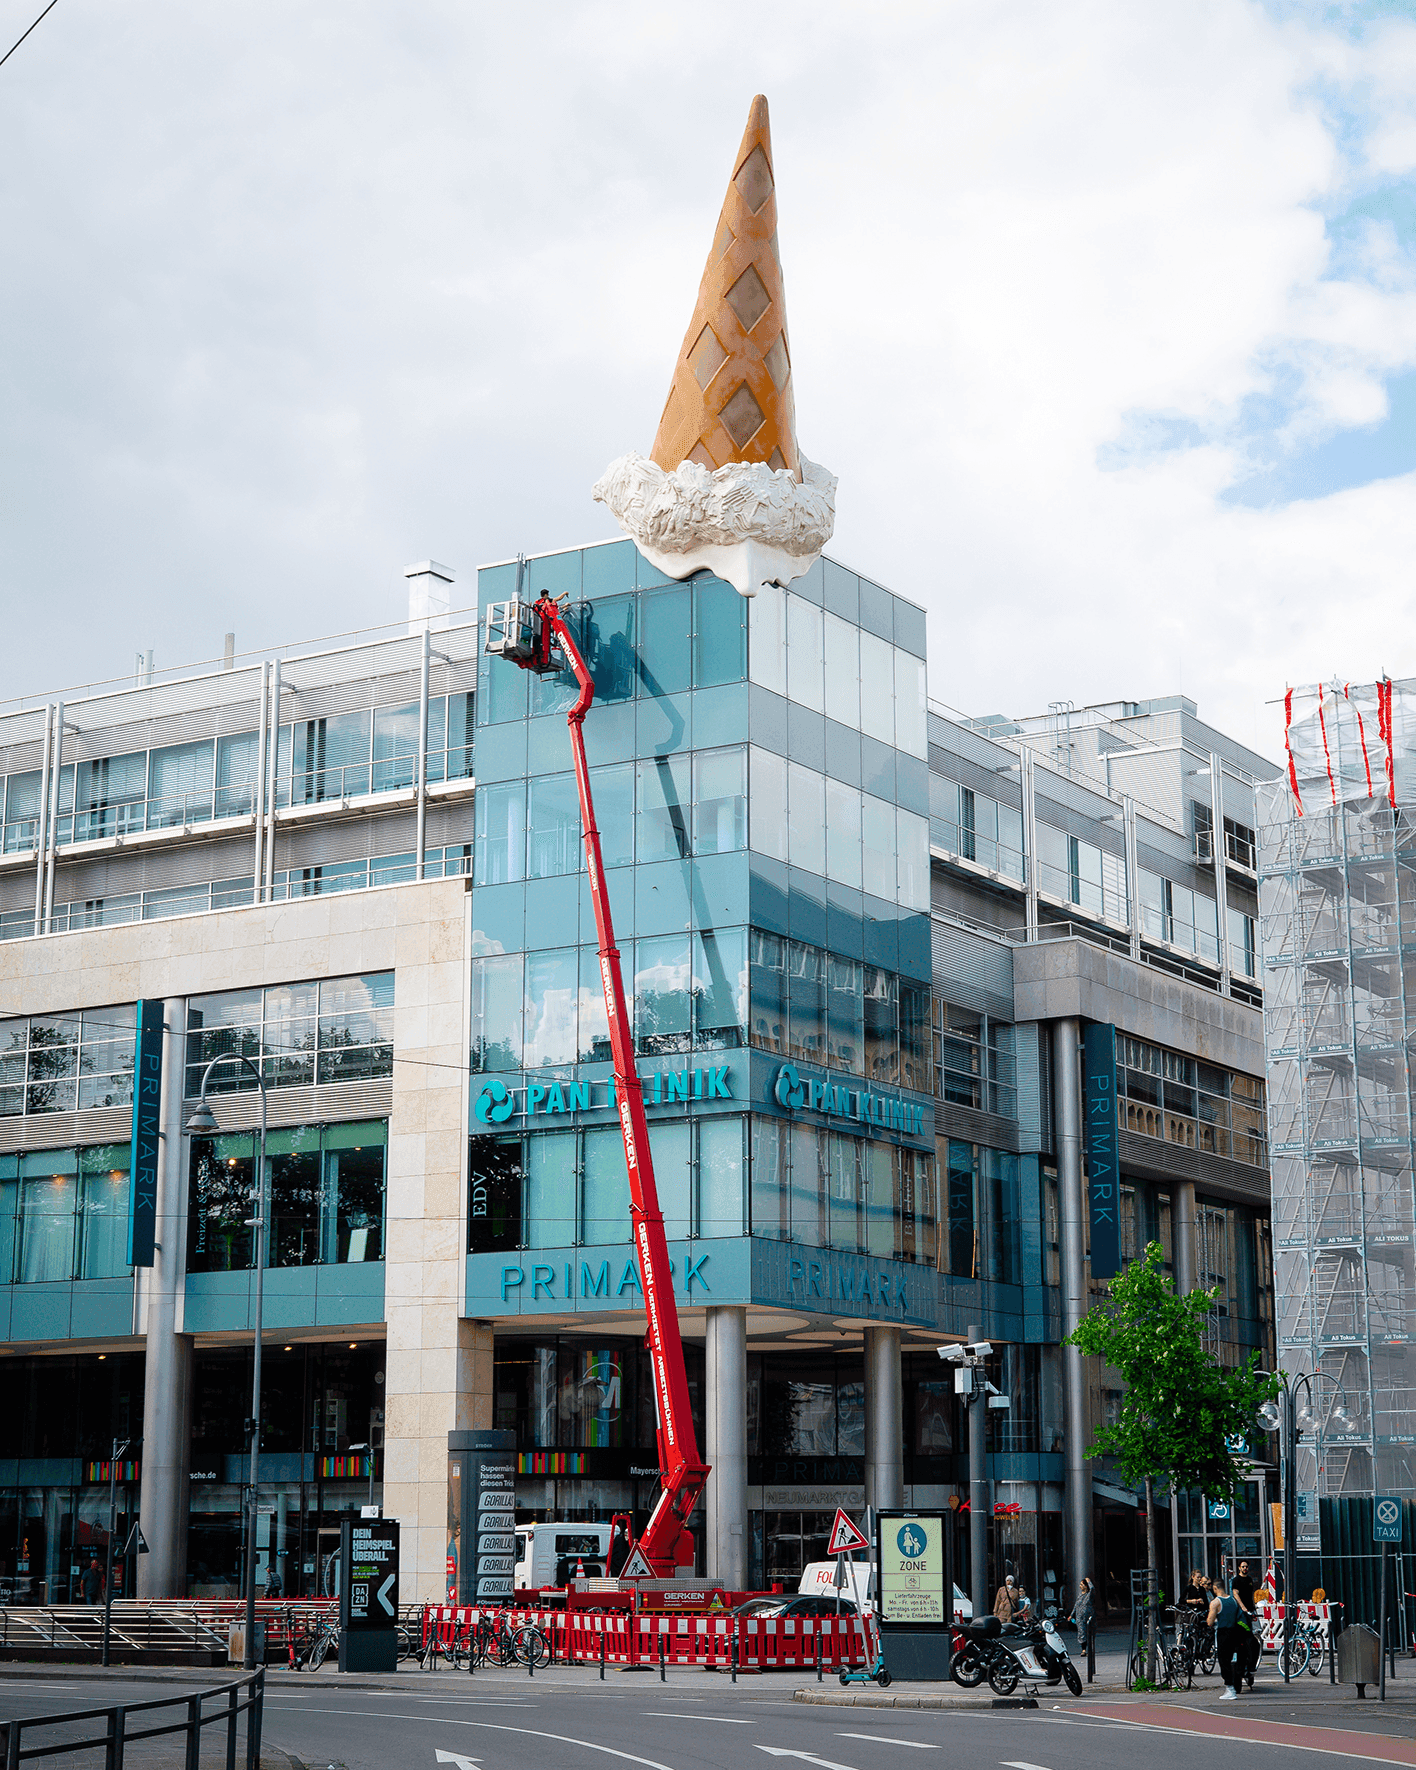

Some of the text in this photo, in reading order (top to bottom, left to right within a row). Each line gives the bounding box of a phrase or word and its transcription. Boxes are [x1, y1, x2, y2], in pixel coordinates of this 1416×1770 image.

[557, 631, 578, 670] GERKEN
[587, 854, 598, 891] GERKEN
[601, 957, 615, 1017] GERKEN
[527, 1079, 591, 1116] PAN
[809, 1078, 925, 1136] PAN KLINIK
[137, 1053, 159, 1210] PRIMARK
[620, 1101, 636, 1170] GERKEN
[1090, 1073, 1114, 1225] PRIMARK
[197, 1191, 208, 1204] &
[472, 1171, 488, 1218] EDV
[195, 1207, 207, 1254] Freizeit
[501, 1254, 710, 1301] PRIMAK
[788, 1258, 909, 1309] PRIMARK
[638, 1222, 674, 1446] GERKEN VERMIETET ARBEITSBÜHNEN
[766, 1491, 847, 1504] NEUMARKT
[352, 1528, 372, 1539] DEIN
[352, 1540, 396, 1550] HEIMSPIEL.
[1377, 1526, 1399, 1537] TAXI
[352, 1549, 389, 1561] ÜBERALL.
[899, 1560, 927, 1571] ZONE
